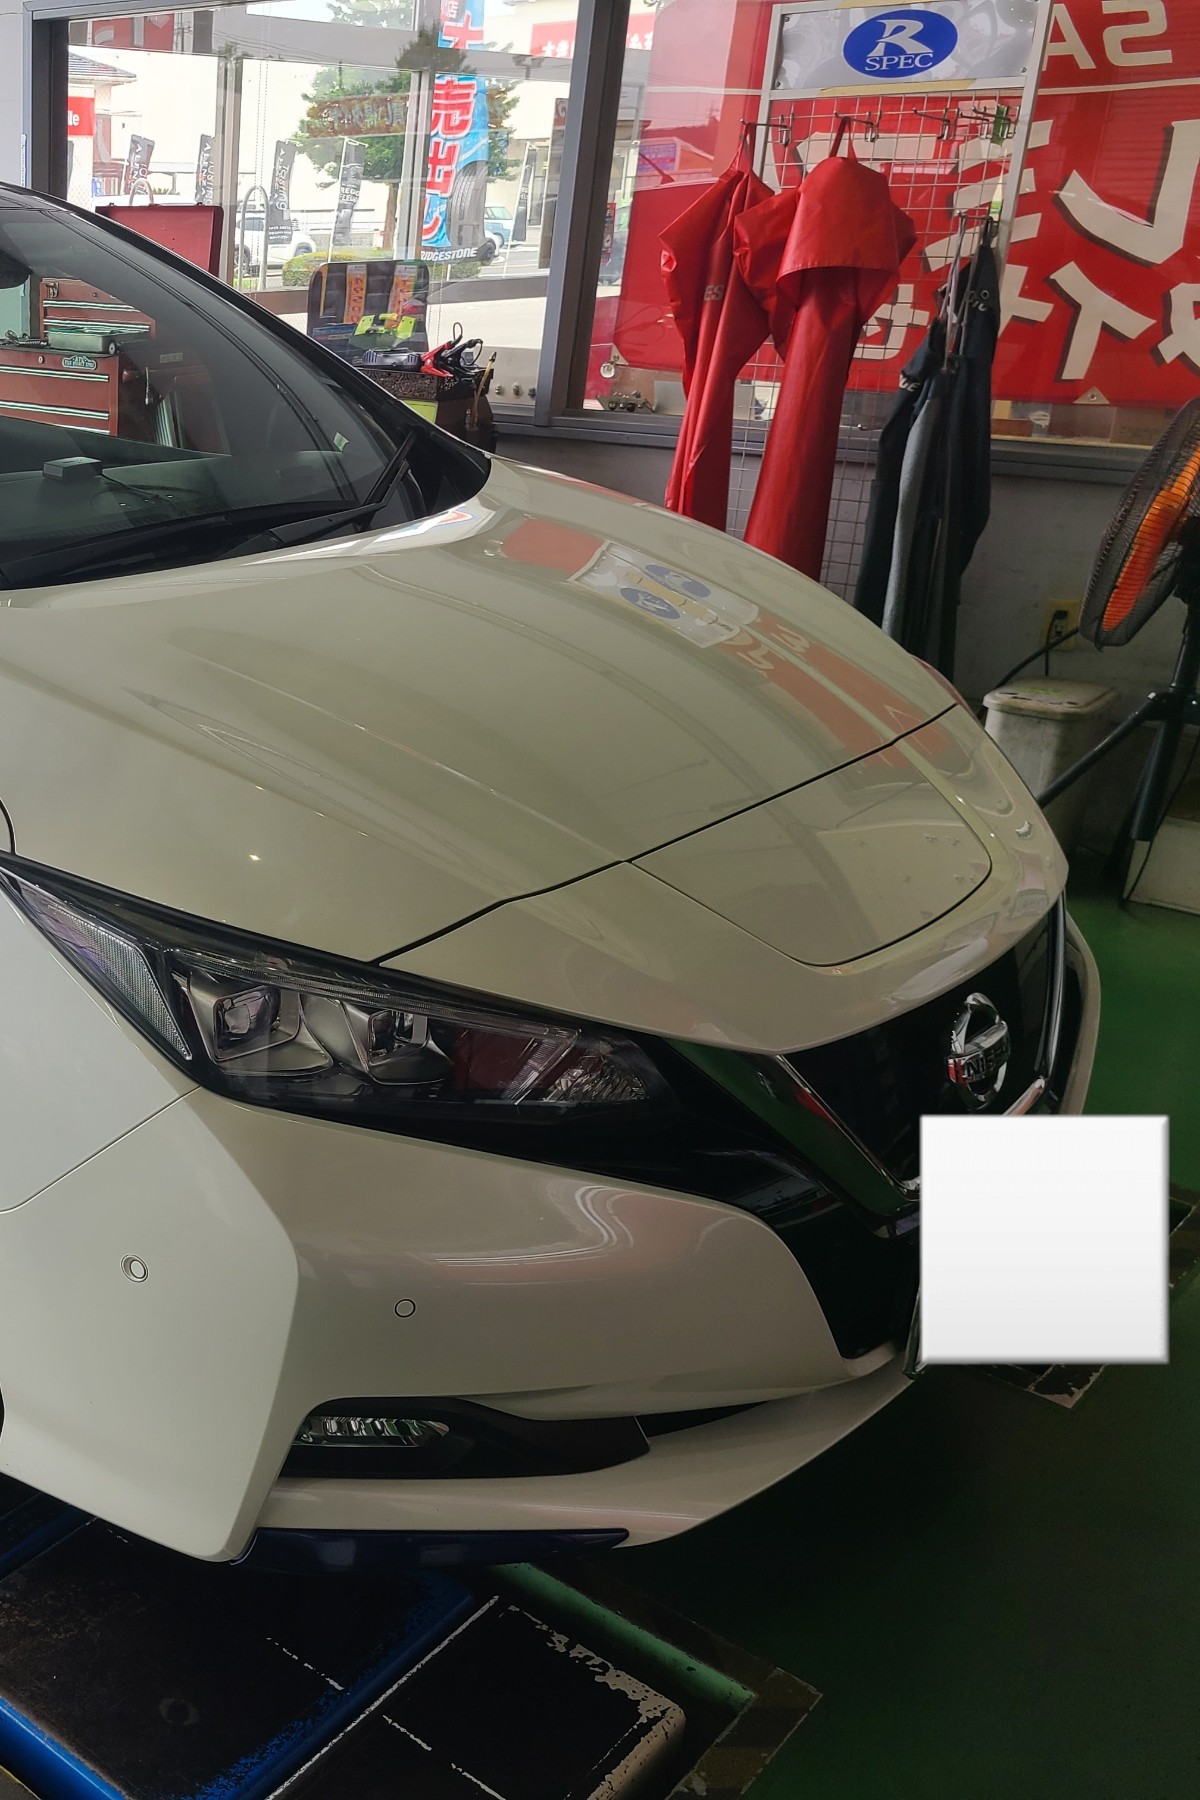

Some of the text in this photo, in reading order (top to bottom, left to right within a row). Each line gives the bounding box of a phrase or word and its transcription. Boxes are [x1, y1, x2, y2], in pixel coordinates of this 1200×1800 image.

[867, 19, 933, 56] R
[865, 52, 934, 71] SPEC
[420, 247, 479, 262] RIDGESTONE
